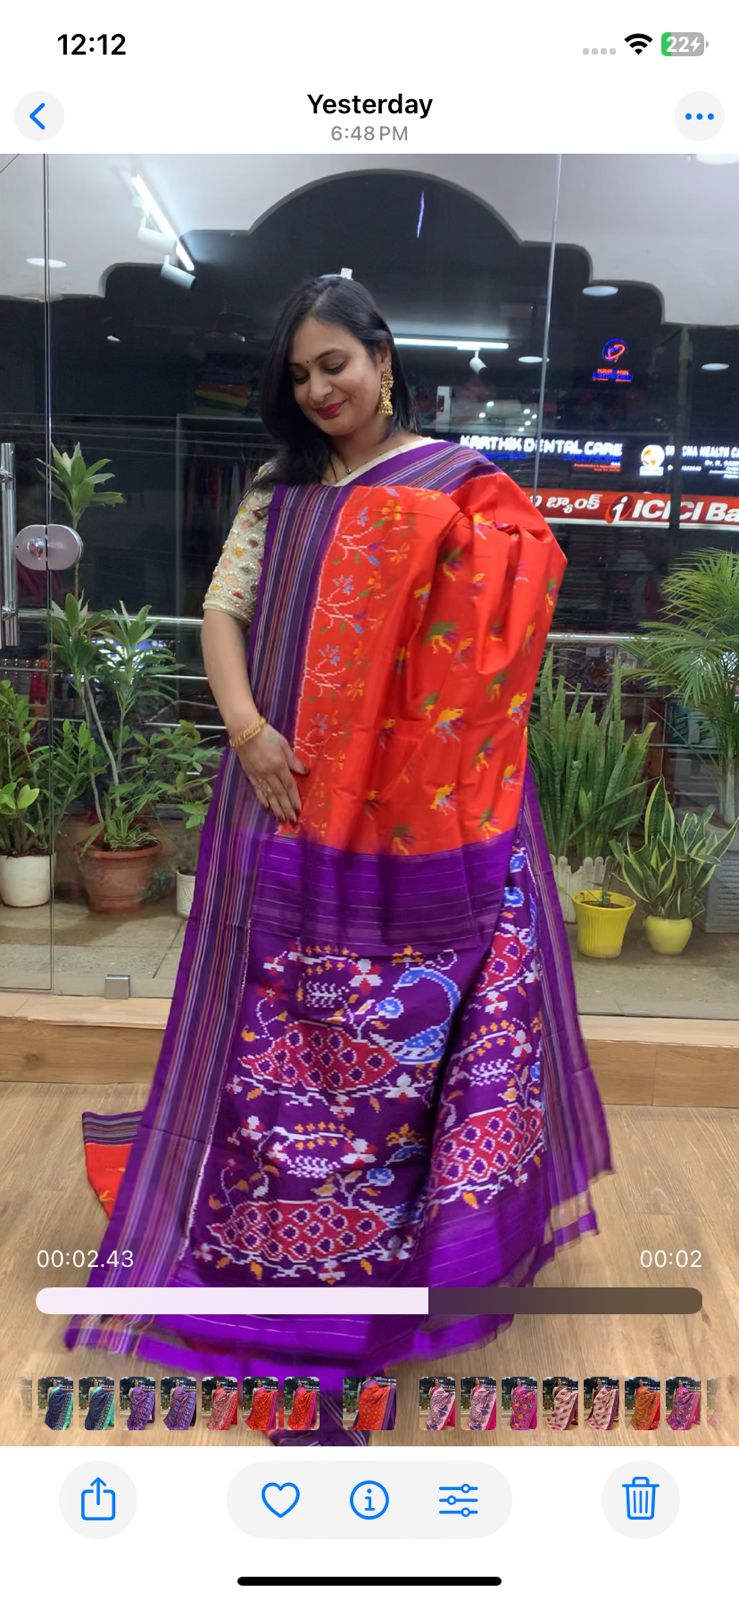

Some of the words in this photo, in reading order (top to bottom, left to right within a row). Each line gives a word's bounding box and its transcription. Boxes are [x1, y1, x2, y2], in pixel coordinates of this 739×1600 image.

[460, 435, 522, 452] KARTHIK
[524, 437, 583, 455] DENTAL
[584, 441, 623, 457] CARE
[631, 499, 705, 521] ICICI
